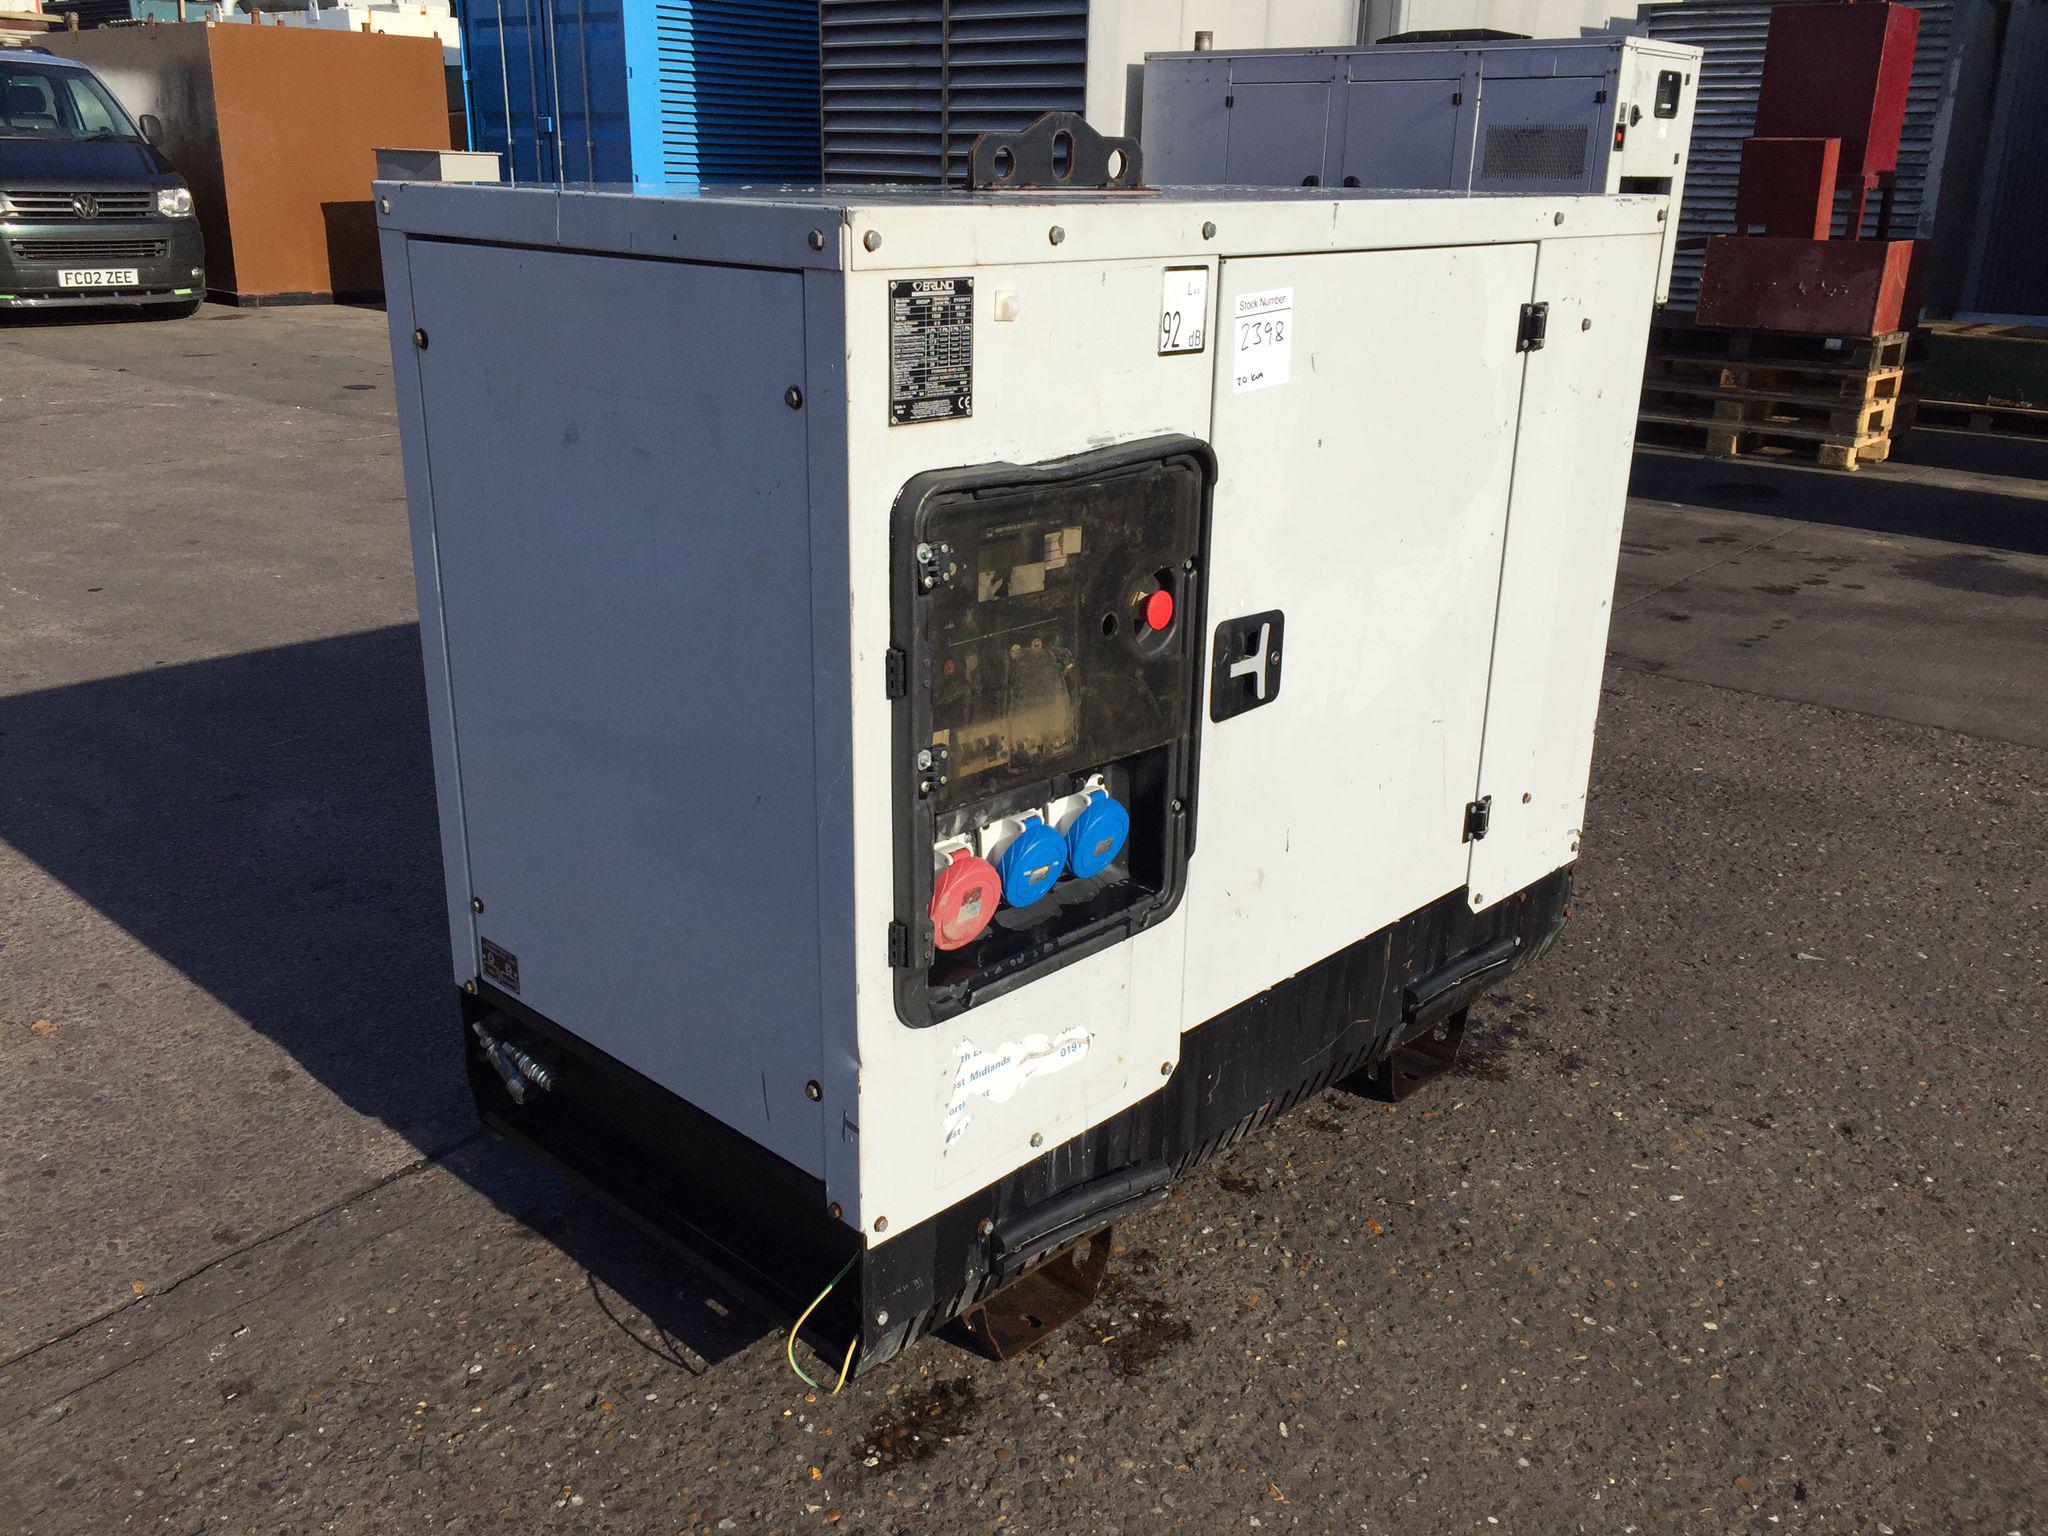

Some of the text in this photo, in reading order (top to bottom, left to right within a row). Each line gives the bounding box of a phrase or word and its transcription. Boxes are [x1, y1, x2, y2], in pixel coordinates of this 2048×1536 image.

[64, 271, 133, 285] FC02 ZEE
[922, 280, 954, 291] BRUNO
[1239, 295, 1286, 311] Stock Number
[1162, 311, 1202, 349] 92 dB
[1241, 320, 1284, 351] 2398
[970, 1056, 1011, 1081] Midlands
